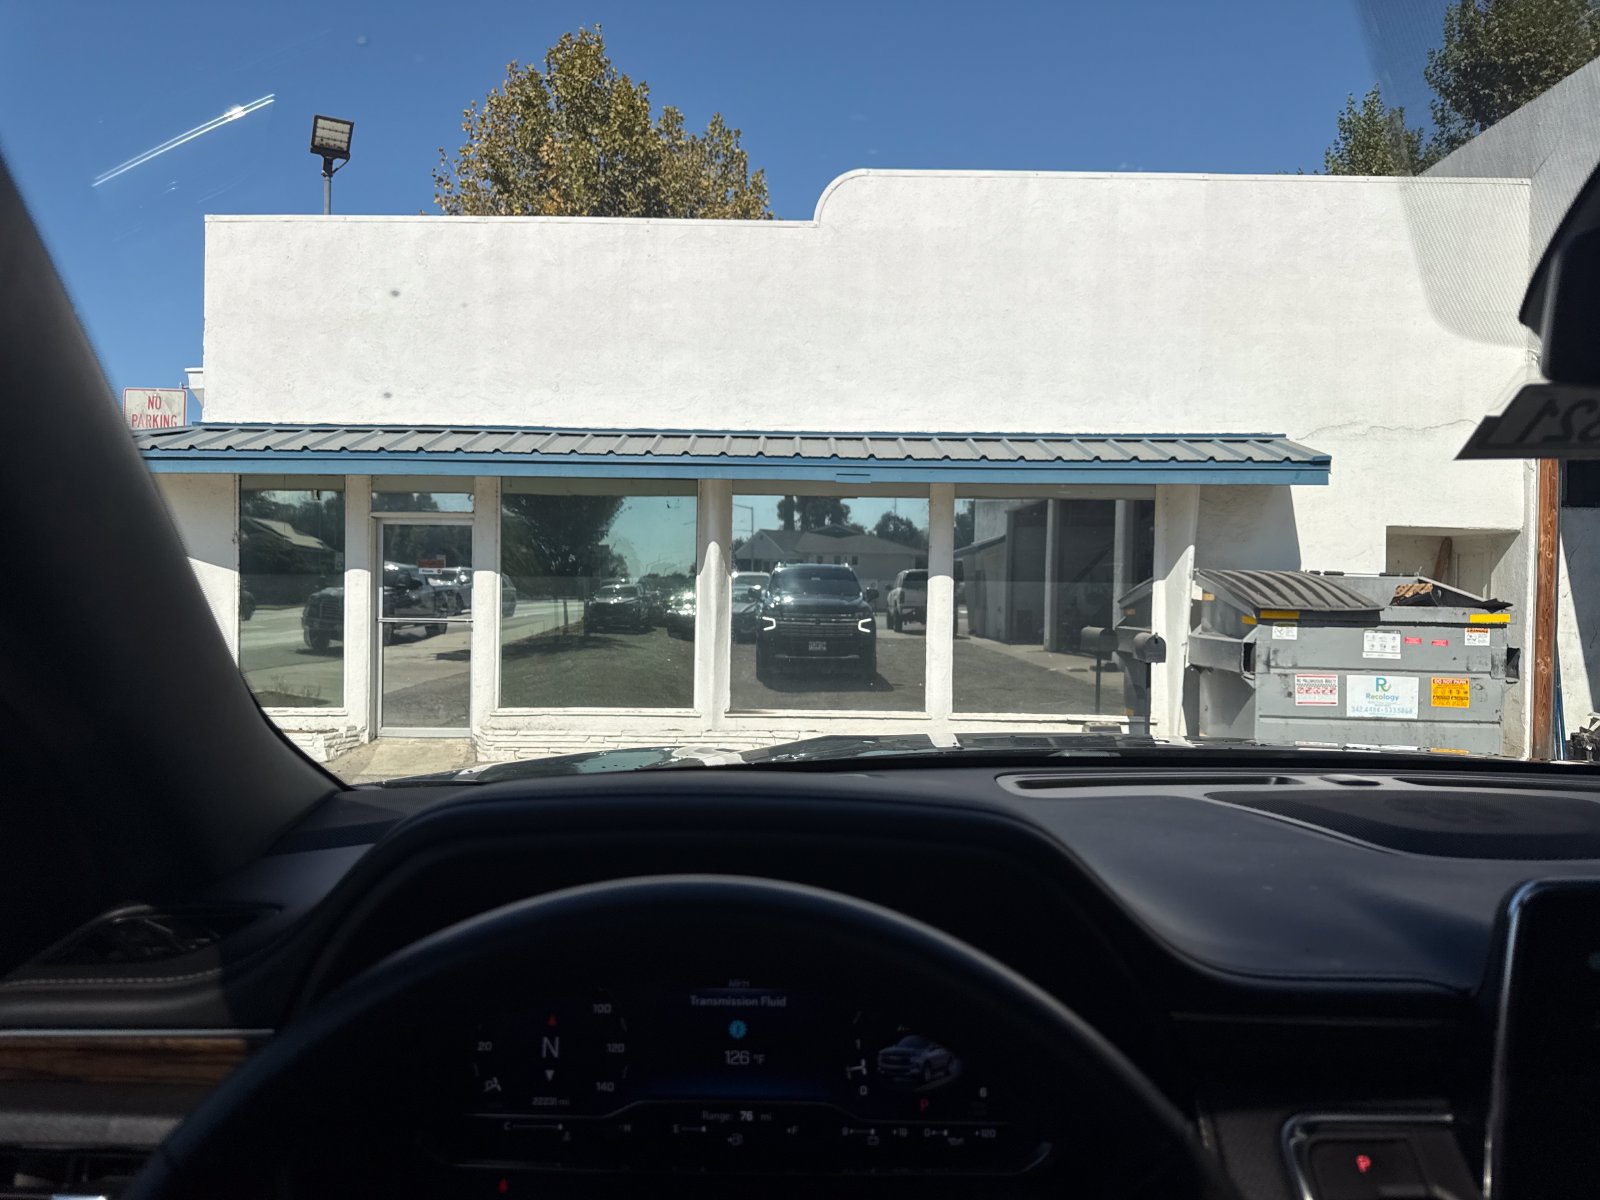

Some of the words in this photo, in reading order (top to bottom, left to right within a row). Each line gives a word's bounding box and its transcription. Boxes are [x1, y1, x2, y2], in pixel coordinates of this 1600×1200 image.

[147, 395, 162, 410] NO
[131, 413, 178, 429] PARKING
[1365, 692, 1399, 702] Recology
[689, 994, 758, 1007] Transmission
[760, 995, 787, 1008] Fluid
[591, 1003, 612, 1015] 100
[477, 1041, 494, 1052] 20
[541, 1036, 560, 1059] N
[606, 1042, 625, 1054] 120
[724, 1049, 750, 1066] 126
[594, 1081, 615, 1092] 140
[739, 1110, 753, 1122] 76
